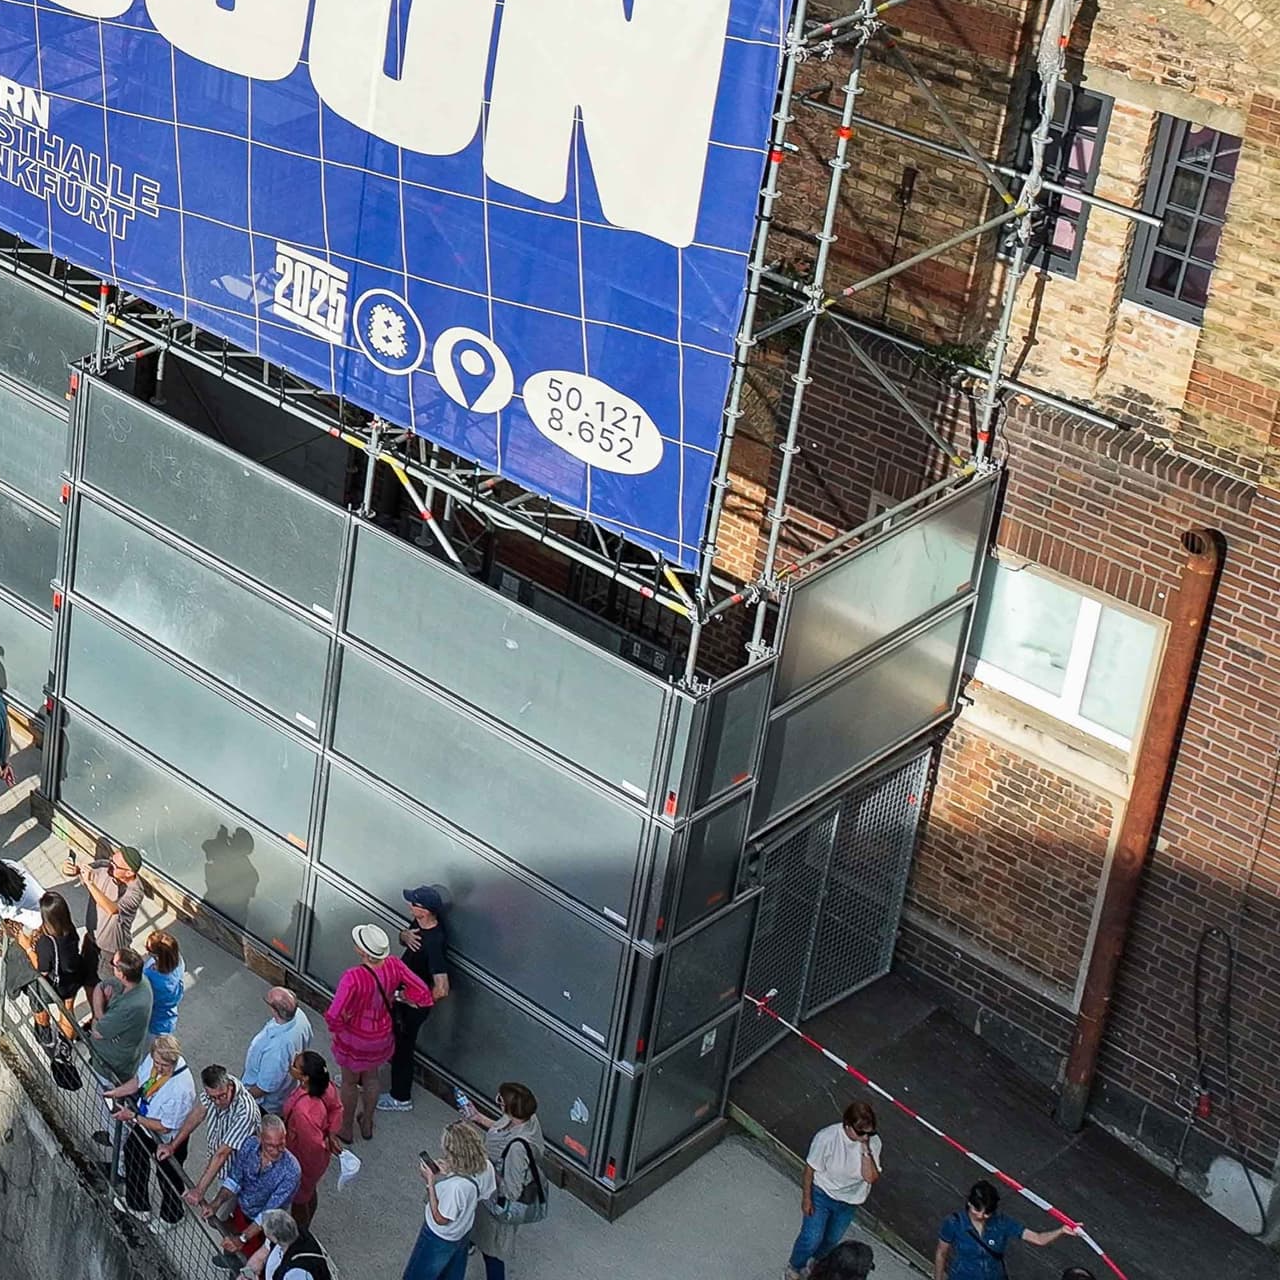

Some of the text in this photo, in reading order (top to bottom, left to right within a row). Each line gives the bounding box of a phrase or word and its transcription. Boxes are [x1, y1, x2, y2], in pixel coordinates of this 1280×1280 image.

[273, 255, 347, 334] 2025
[547, 377, 642, 439] 50.121
[547, 406, 634, 463] 8.652
